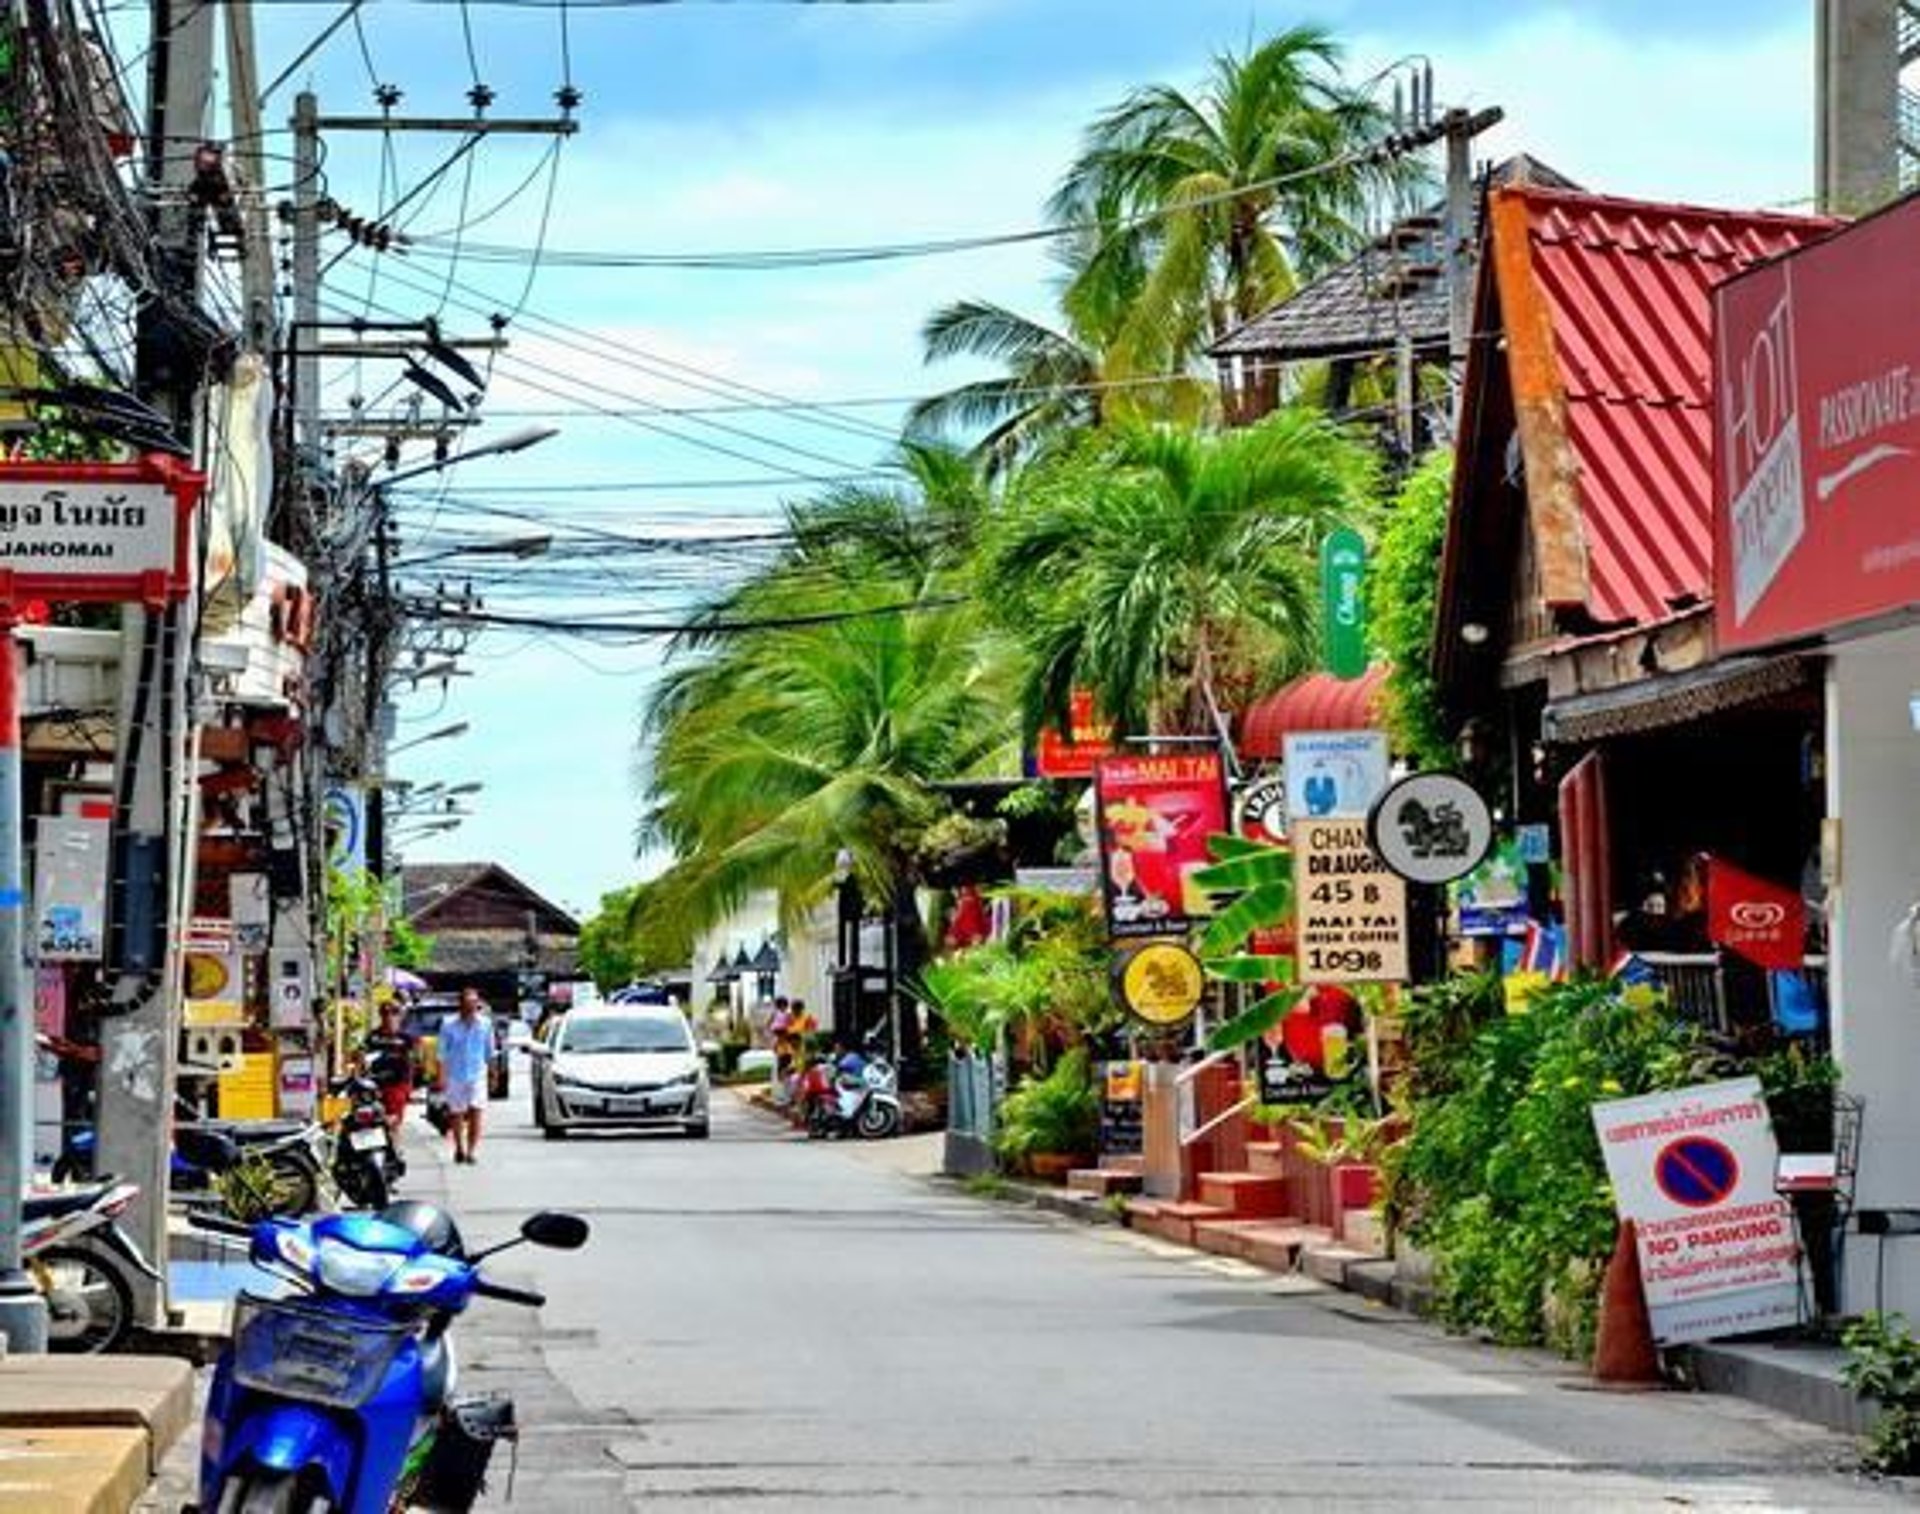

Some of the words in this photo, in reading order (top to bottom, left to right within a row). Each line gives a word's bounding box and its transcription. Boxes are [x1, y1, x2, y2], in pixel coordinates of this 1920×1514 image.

[1310, 827, 1369, 850] CHAN
[1309, 853, 1387, 875] DRAUGH
[1310, 880, 1354, 904] 45
[1308, 916, 1353, 928] MAI
[1360, 915, 1397, 928] TAI
[1647, 1236, 1680, 1256] NO
[1686, 1209, 1783, 1248] PARKING
